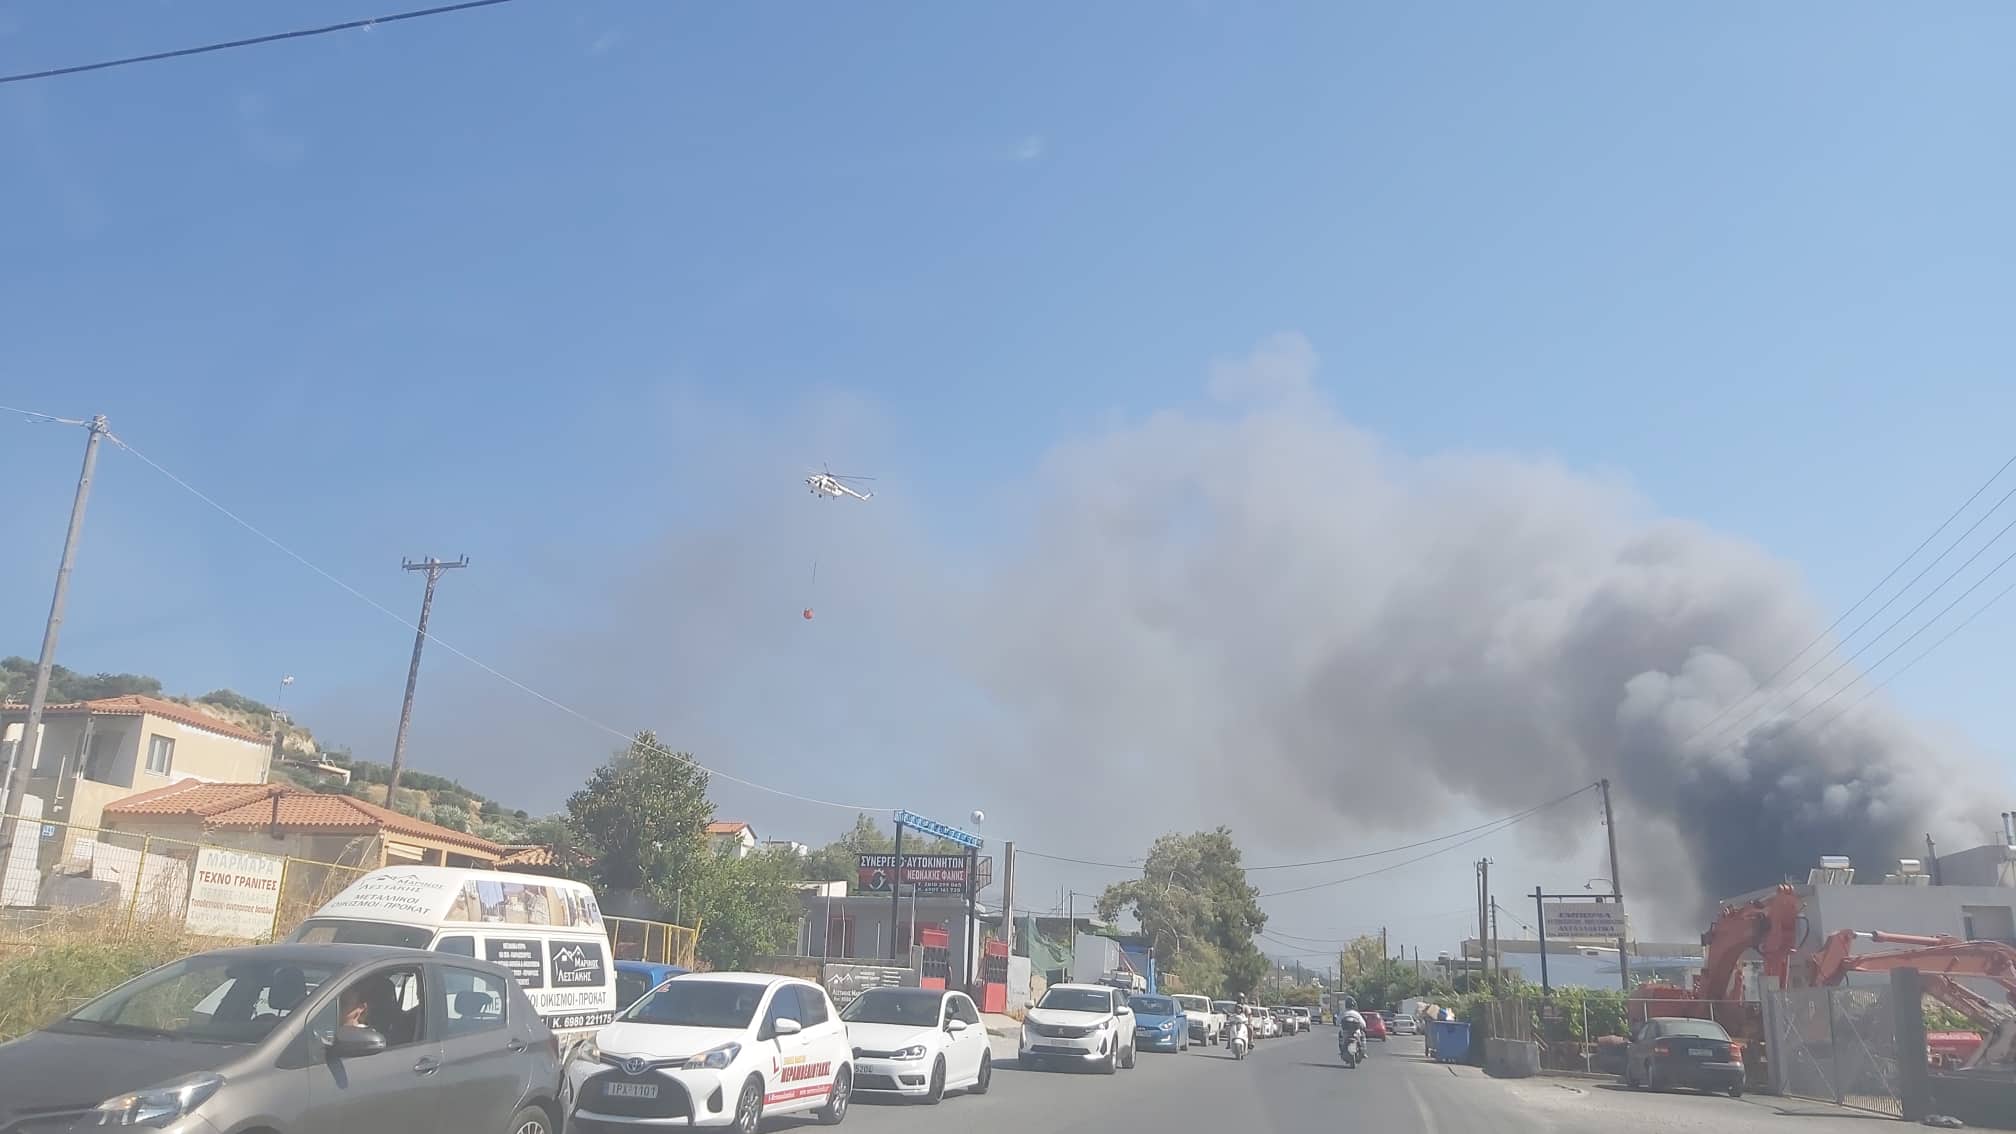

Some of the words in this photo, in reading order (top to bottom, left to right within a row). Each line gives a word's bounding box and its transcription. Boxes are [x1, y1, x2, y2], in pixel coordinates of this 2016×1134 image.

[200, 870, 231, 885] ΤΕΧΝΟ
[234, 876, 277, 891] ΓΡΑΝΙΤΕΣ
[558, 968, 592, 982] ΛΕΣΤΑΚΗΣ
[564, 1015, 583, 1027] 6980
[586, 1013, 612, 1025] 221175
